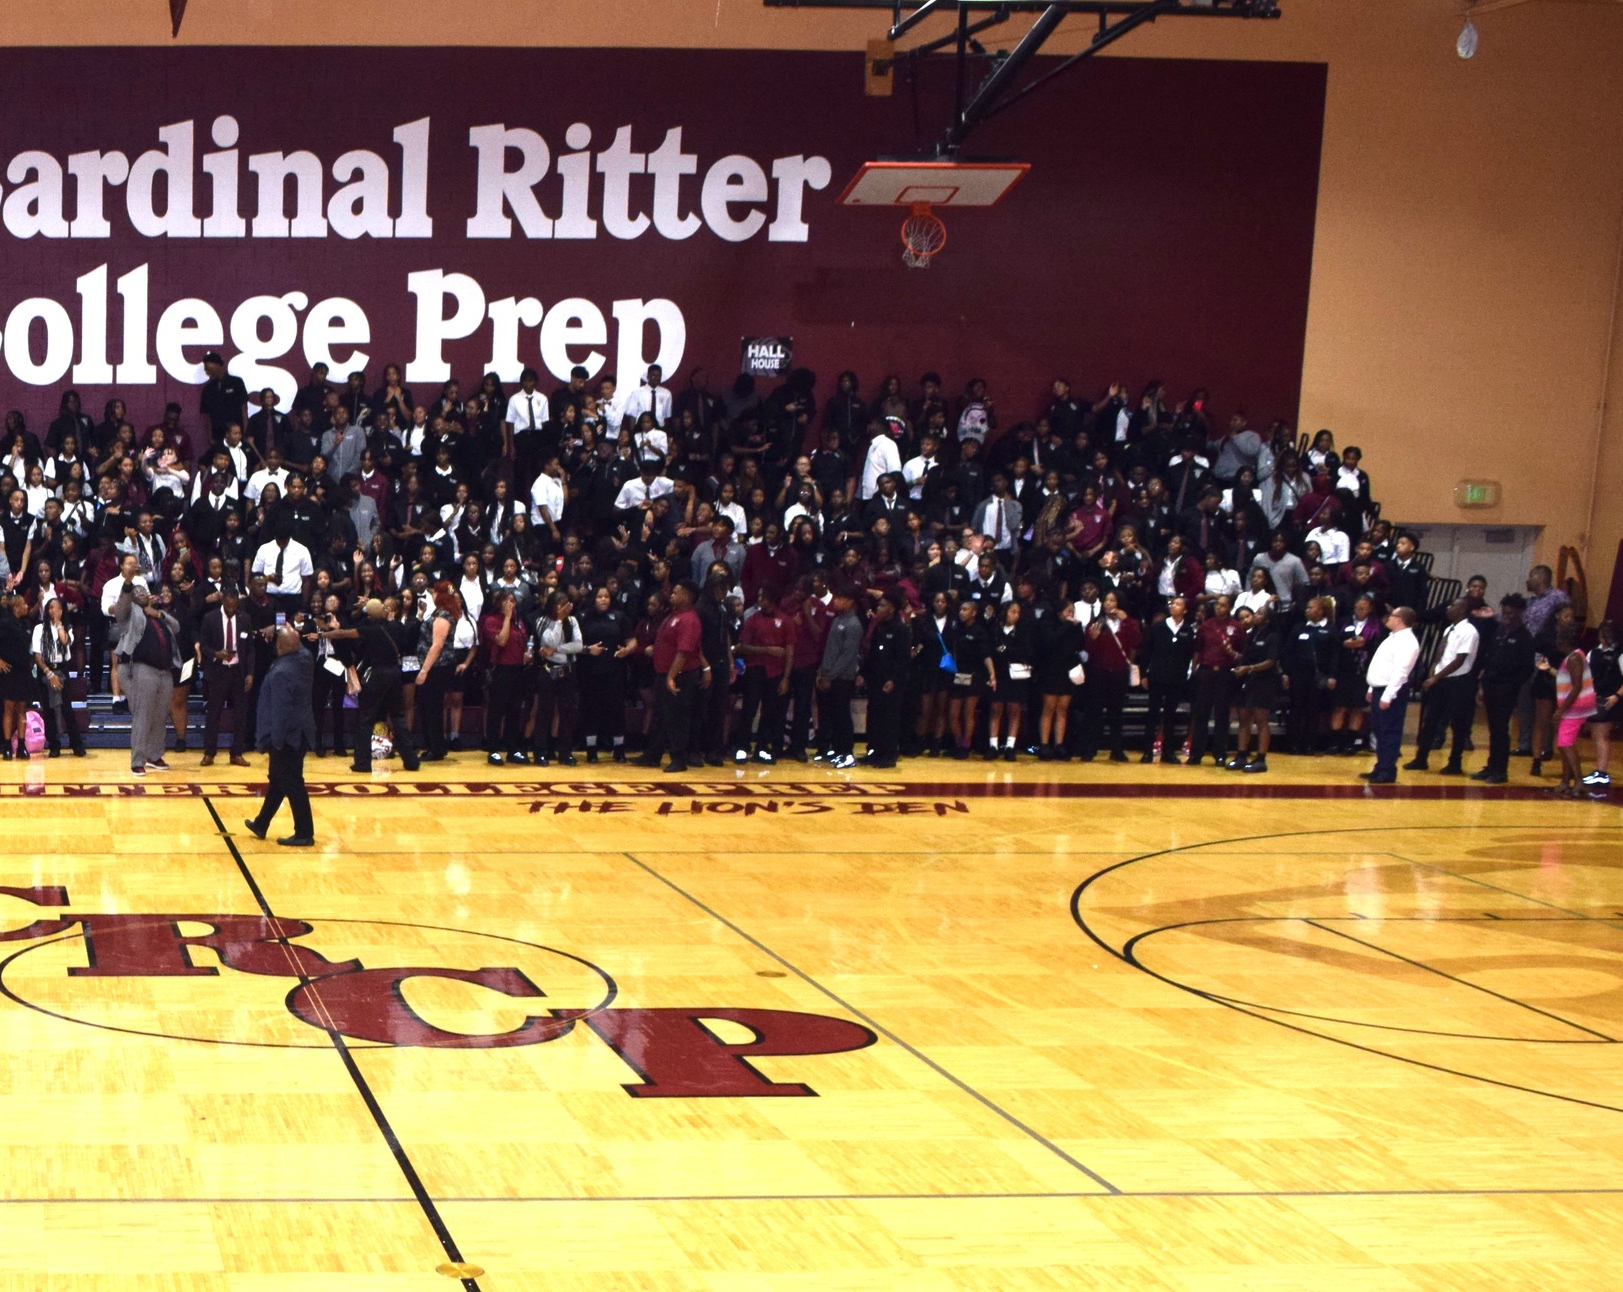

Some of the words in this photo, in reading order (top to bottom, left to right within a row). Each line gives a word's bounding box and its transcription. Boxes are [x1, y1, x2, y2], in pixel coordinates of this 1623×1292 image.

[466, 123, 833, 243] Ritter
[405, 268, 687, 404] Prep
[747, 344, 785, 358] HALL
[751, 358, 780, 369] HOUSE
[681, 783, 907, 795] PREP
[516, 799, 638, 815] THE
[654, 799, 835, 817] LION'S
[844, 800, 970, 816] DEN
